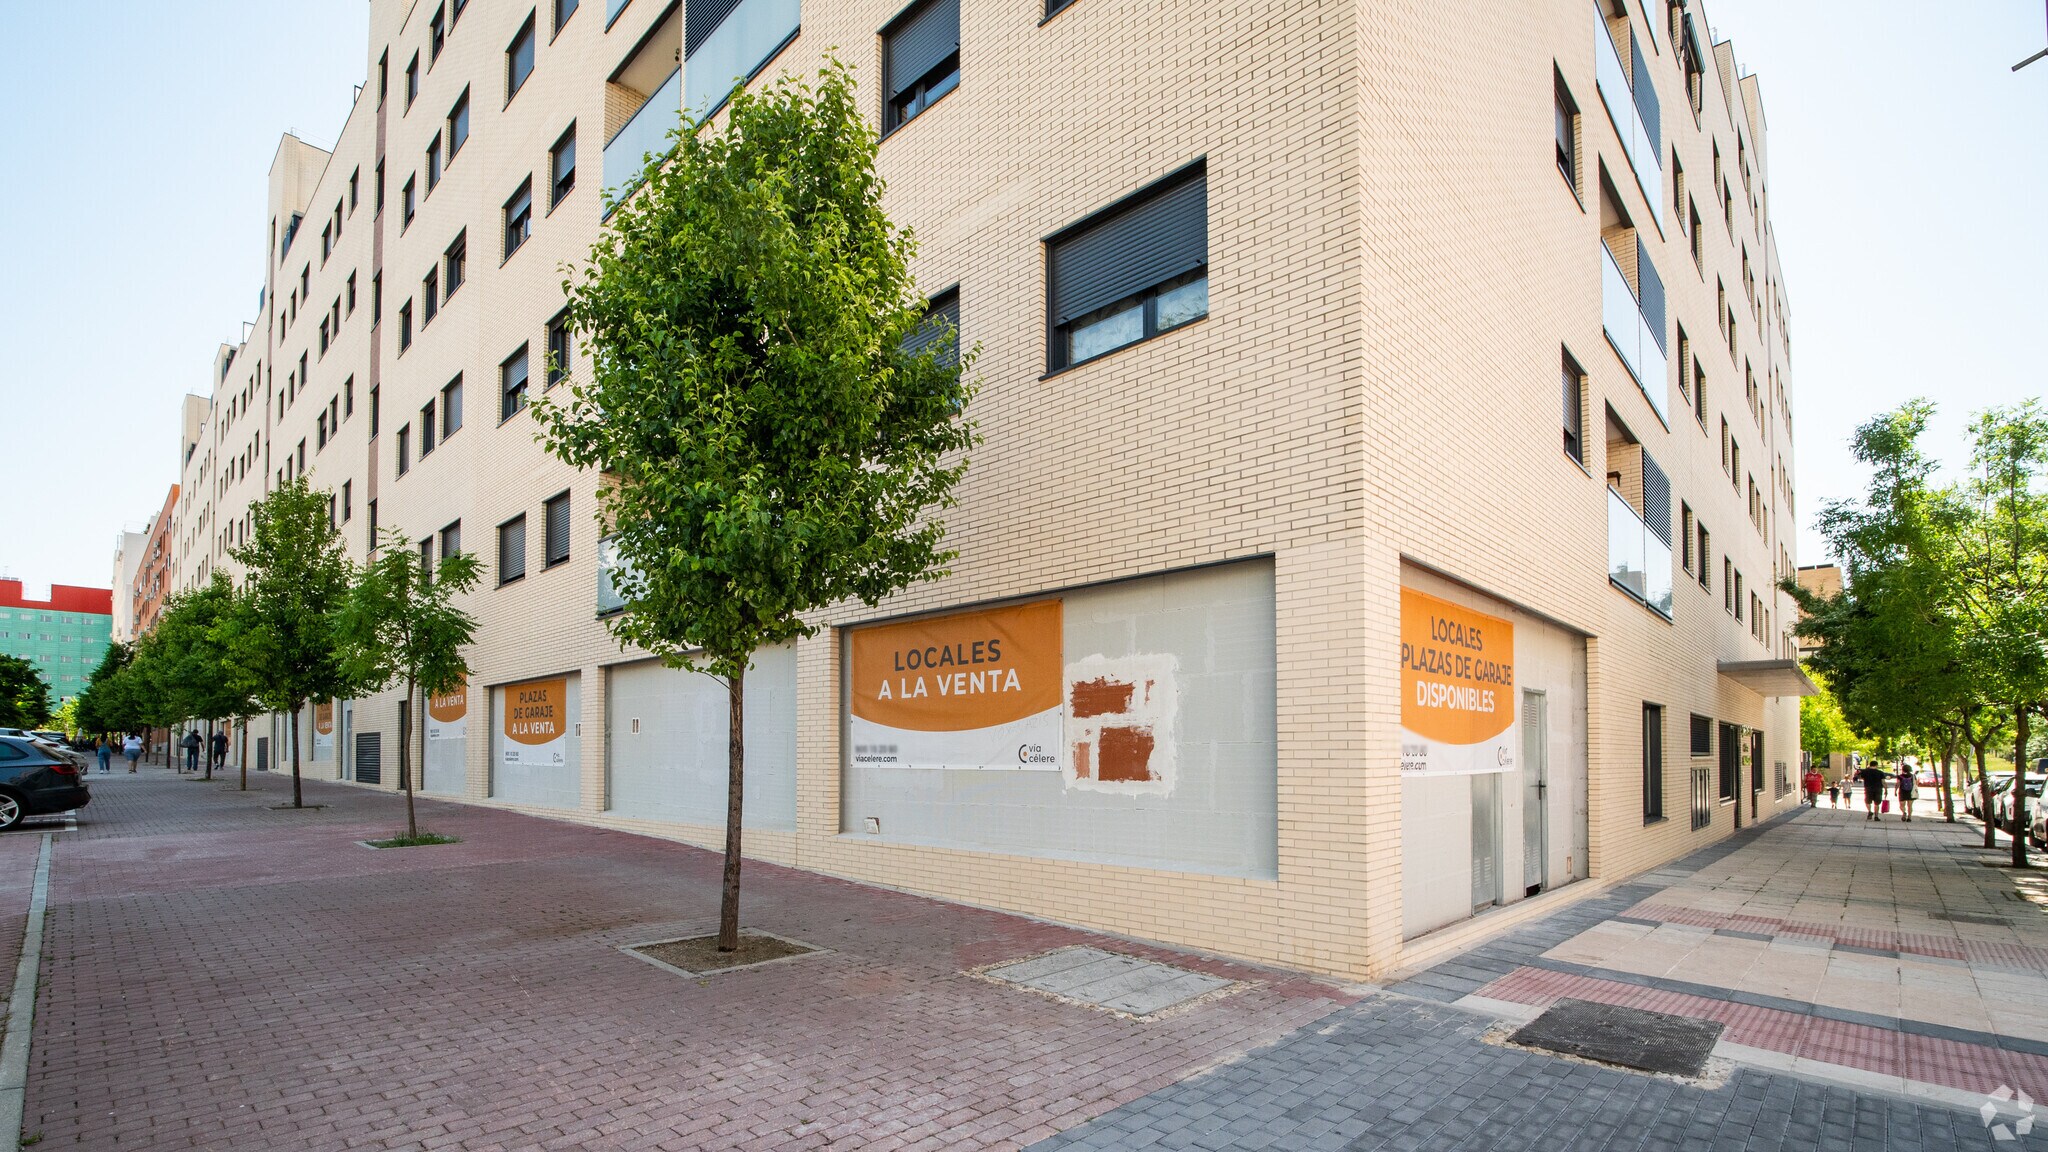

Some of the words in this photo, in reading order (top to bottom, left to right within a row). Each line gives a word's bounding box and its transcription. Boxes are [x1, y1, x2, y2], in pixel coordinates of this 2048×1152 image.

[1431, 616, 1482, 651] LOCALES
[894, 639, 1001, 672] LOCALES
[1401, 642, 1451, 677] PLAZAS
[1456, 654, 1472, 680] DE
[1474, 658, 1512, 686] GARAJE
[878, 680, 892, 700] A
[901, 676, 928, 699] LA
[936, 668, 1022, 696] VENTA
[434, 698, 439, 708] A
[440, 697, 446, 708] LA
[446, 694, 464, 706] VENTA
[520, 690, 547, 704] PLAZAS
[1416, 680, 1495, 713] DISPONIBLES
[514, 708, 522, 719] DE
[525, 705, 553, 719] GARAJE
[512, 723, 518, 735] A
[520, 722, 528, 734] LA
[530, 721, 555, 734] VENTA
[855, 754, 898, 762] viacelere.com
[1028, 754, 1055, 763] célere
